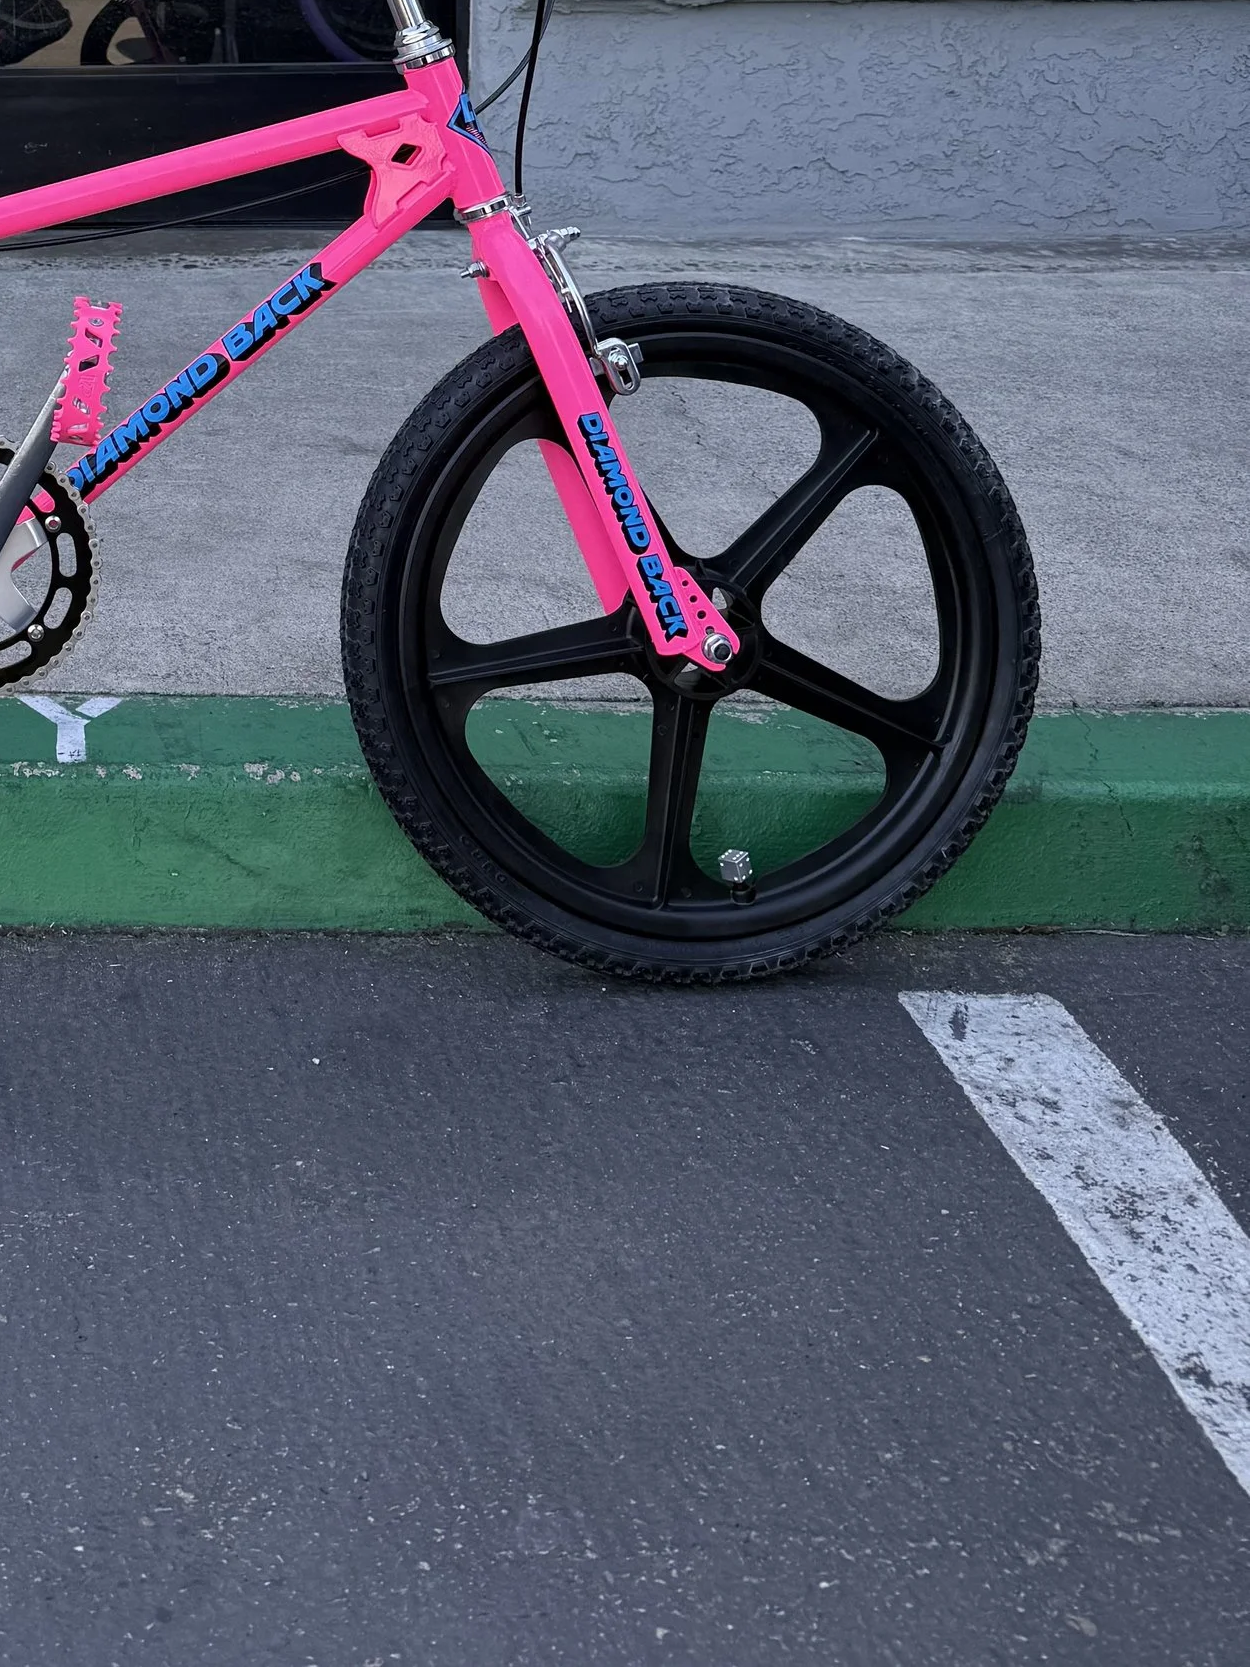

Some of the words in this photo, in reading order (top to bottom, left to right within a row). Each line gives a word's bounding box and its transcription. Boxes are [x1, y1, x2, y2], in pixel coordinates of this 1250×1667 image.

[66, 352, 231, 491] DIAMOND
[221, 262, 338, 361] BACK
[577, 412, 652, 556] DIAMOND
[636, 553, 689, 643] BACK
